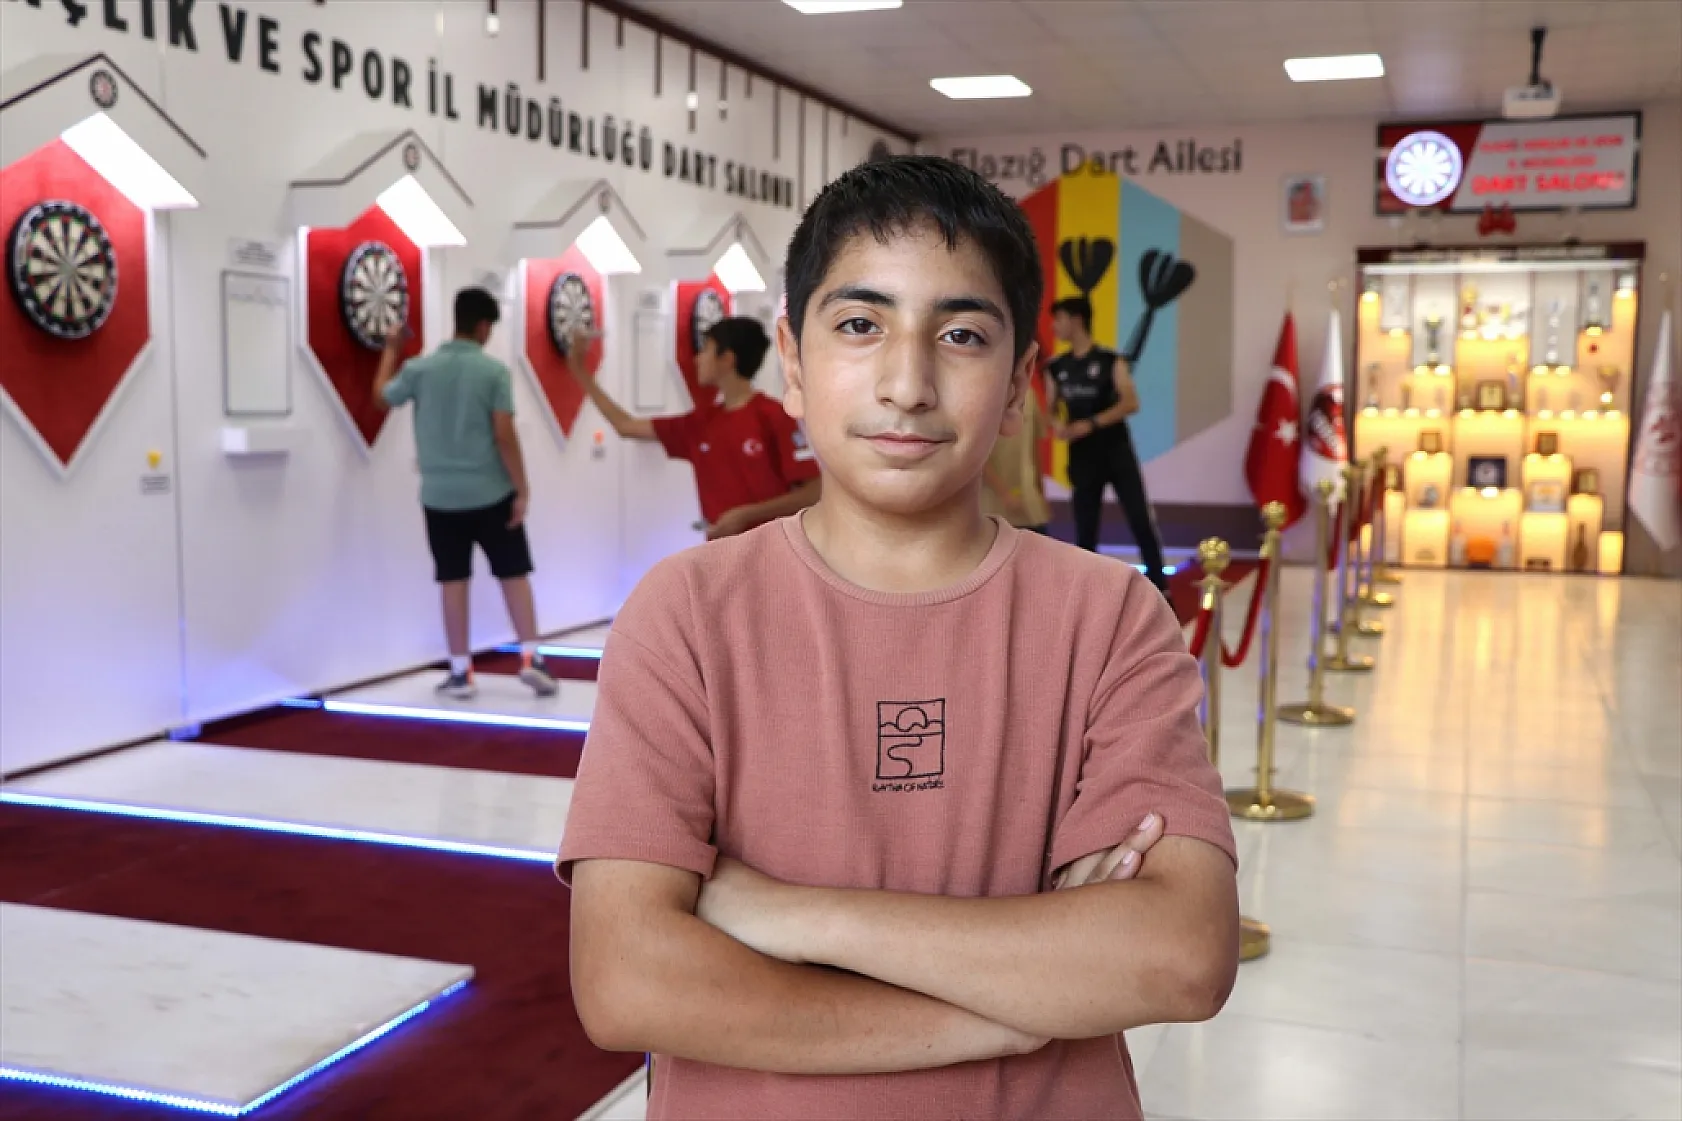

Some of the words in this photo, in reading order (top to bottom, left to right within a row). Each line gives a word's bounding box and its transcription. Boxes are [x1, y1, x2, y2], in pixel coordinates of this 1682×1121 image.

[219, 3, 280, 74] VE
[302, 31, 412, 108] SPOR
[428, 57, 459, 119] İL
[477, 82, 652, 171] MÜDÜRLÜĞÜ
[663, 140, 717, 188] DART
[725, 161, 793, 208] SALONU
[1060, 142, 1138, 175] Dart
[1147, 137, 1243, 173] Ailesi
[1472, 174, 1526, 194] DART
